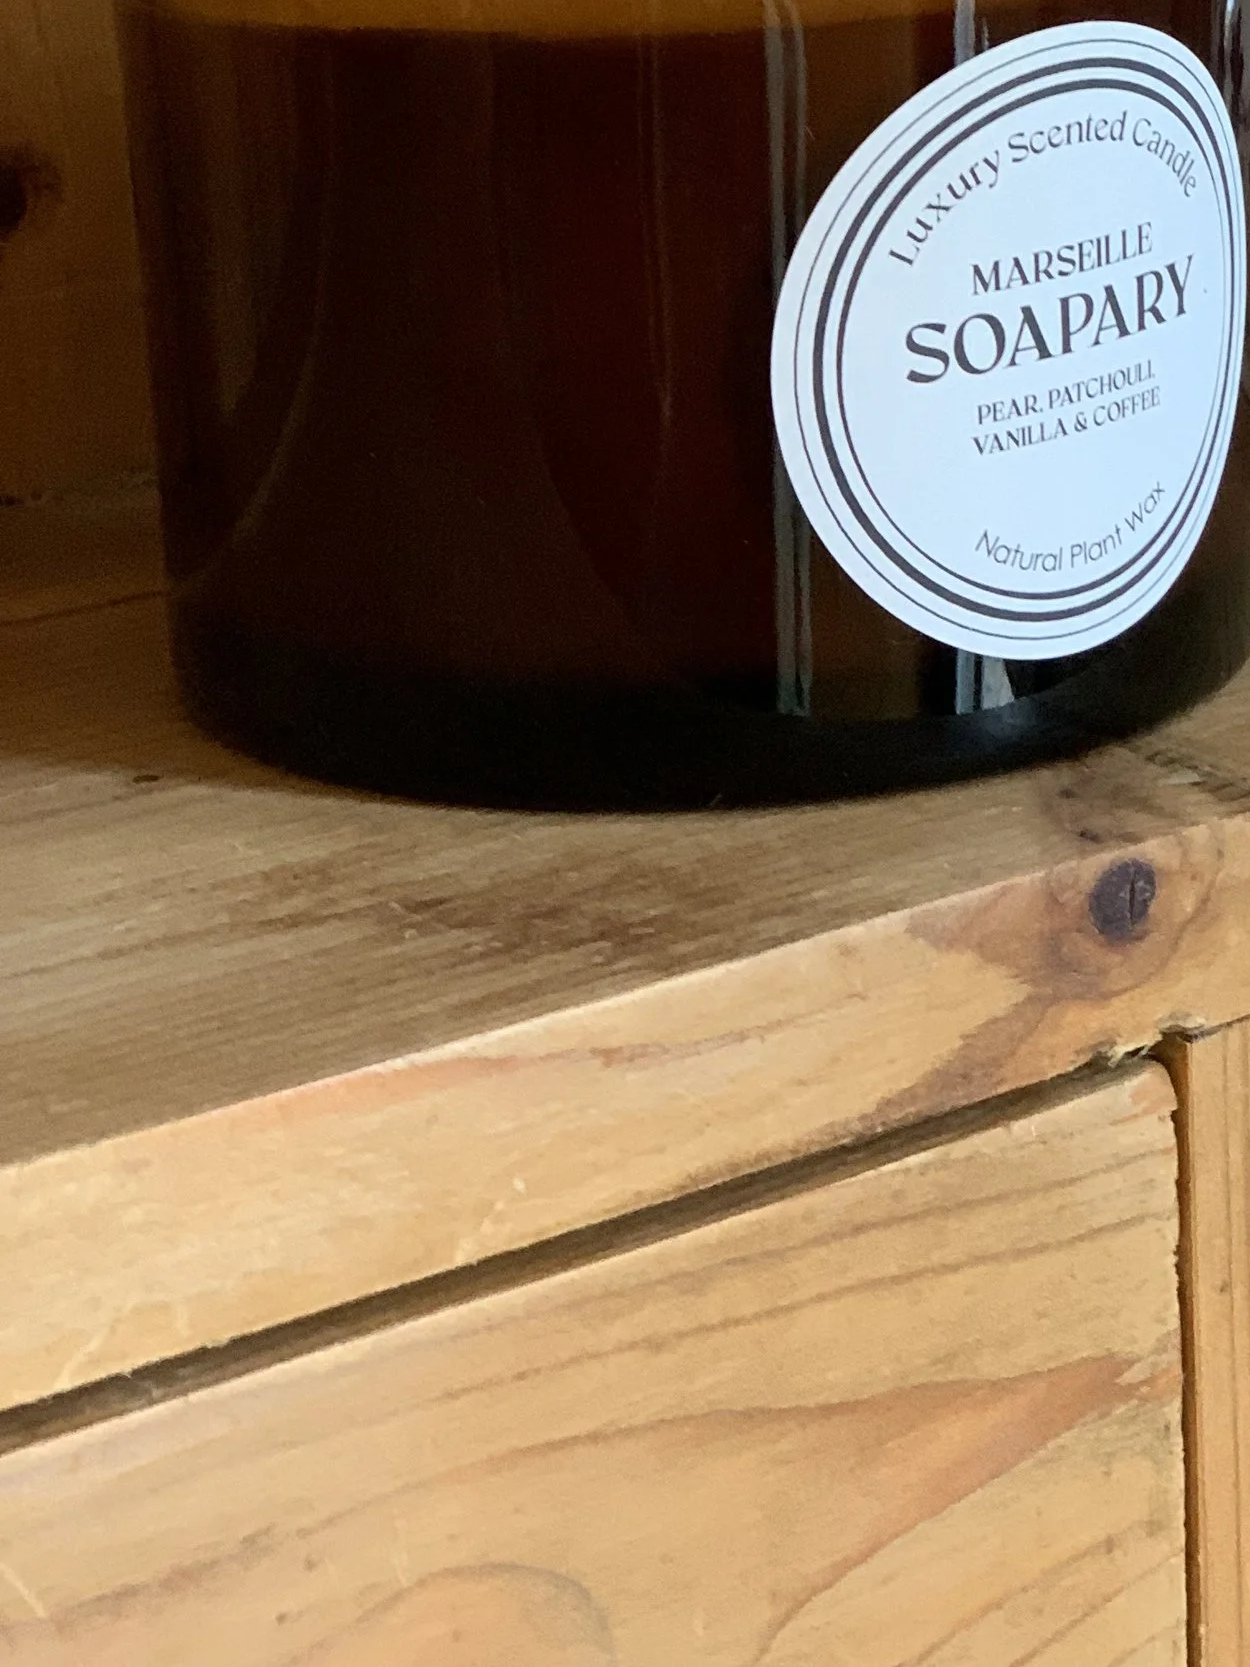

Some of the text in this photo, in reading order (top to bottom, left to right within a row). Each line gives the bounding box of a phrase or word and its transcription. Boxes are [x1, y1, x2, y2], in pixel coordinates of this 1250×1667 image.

[887, 109, 1197, 268] Luxury Scented Candle
[971, 221, 1153, 296] MARSEILLE
[905, 253, 1195, 384] SOAPARY
[971, 386, 1161, 456] VANILLA & COFFEE
[974, 480, 1166, 573] Natural Plant Wax
